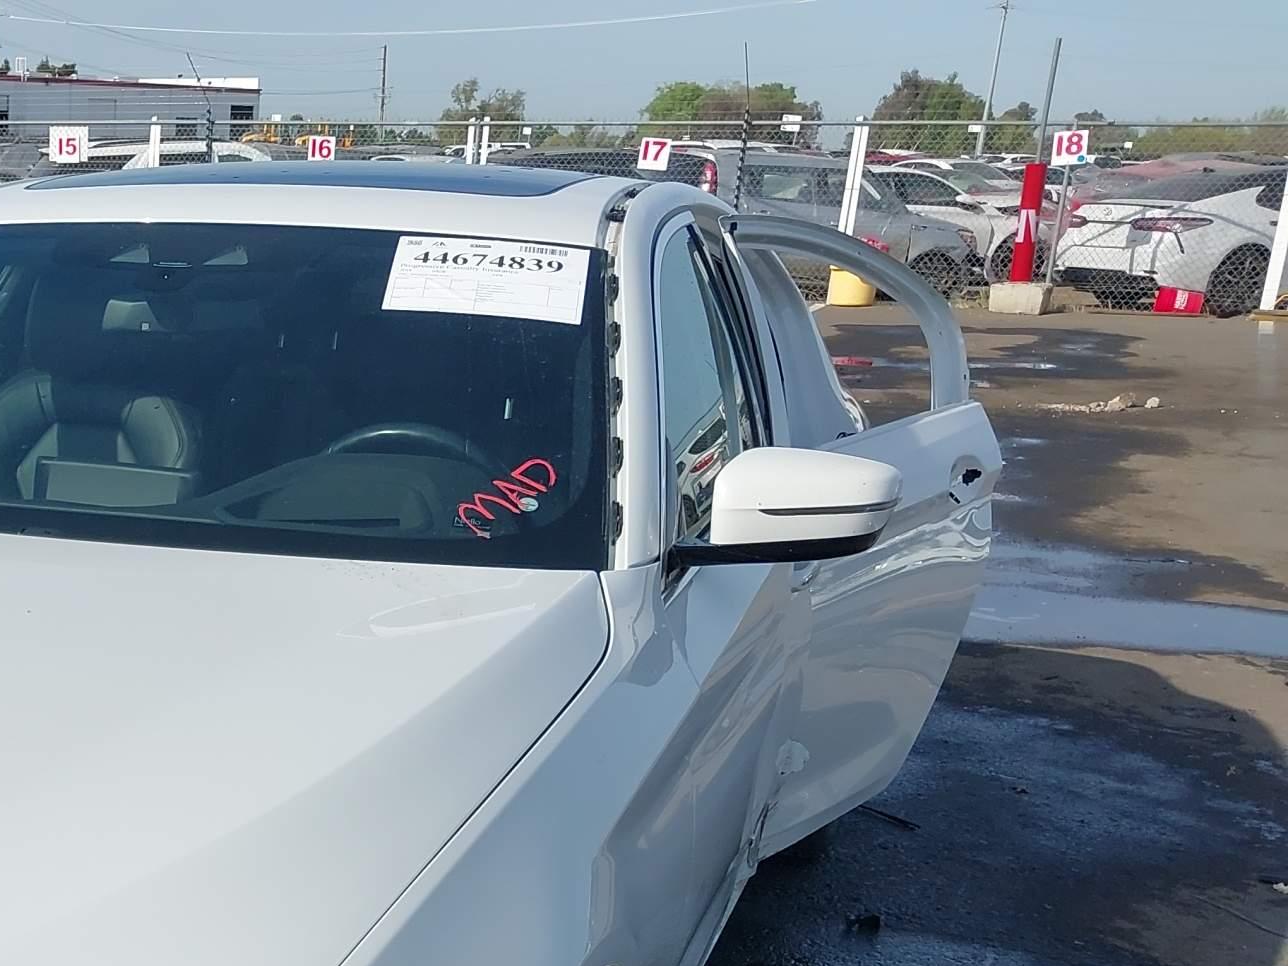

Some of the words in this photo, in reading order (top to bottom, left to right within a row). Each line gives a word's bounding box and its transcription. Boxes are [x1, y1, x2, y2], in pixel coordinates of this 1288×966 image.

[59, 138, 77, 155] 15
[312, 139, 331, 158] 16
[642, 141, 668, 161] 17
[1056, 133, 1083, 156] 18
[414, 251, 564, 273] 44674839
